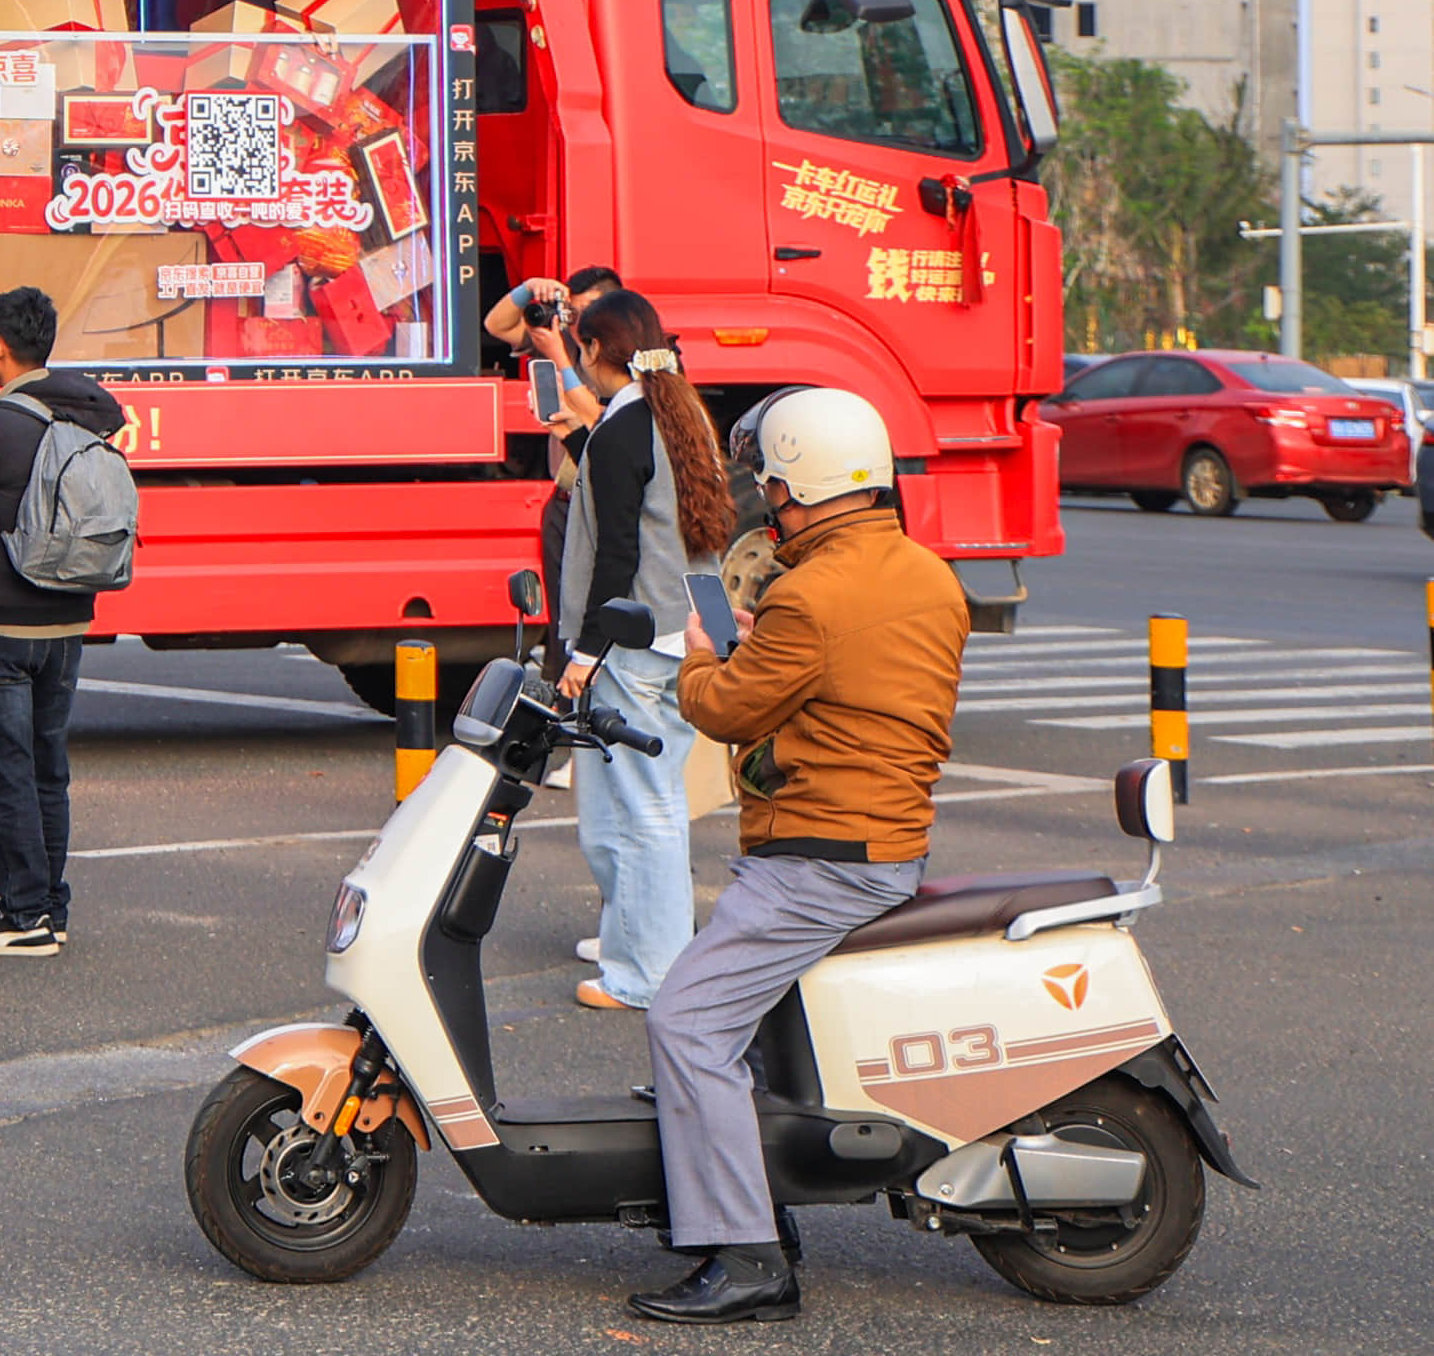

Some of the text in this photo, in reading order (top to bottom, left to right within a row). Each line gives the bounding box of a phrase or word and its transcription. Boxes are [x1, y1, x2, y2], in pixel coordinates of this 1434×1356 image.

[452, 78, 474, 286] 打开京东APP
[164, 201, 306, 221] 扫码查收一吨的爱
[866, 246, 912, 303] 钱
[889, 1023, 1003, 1077] 03
